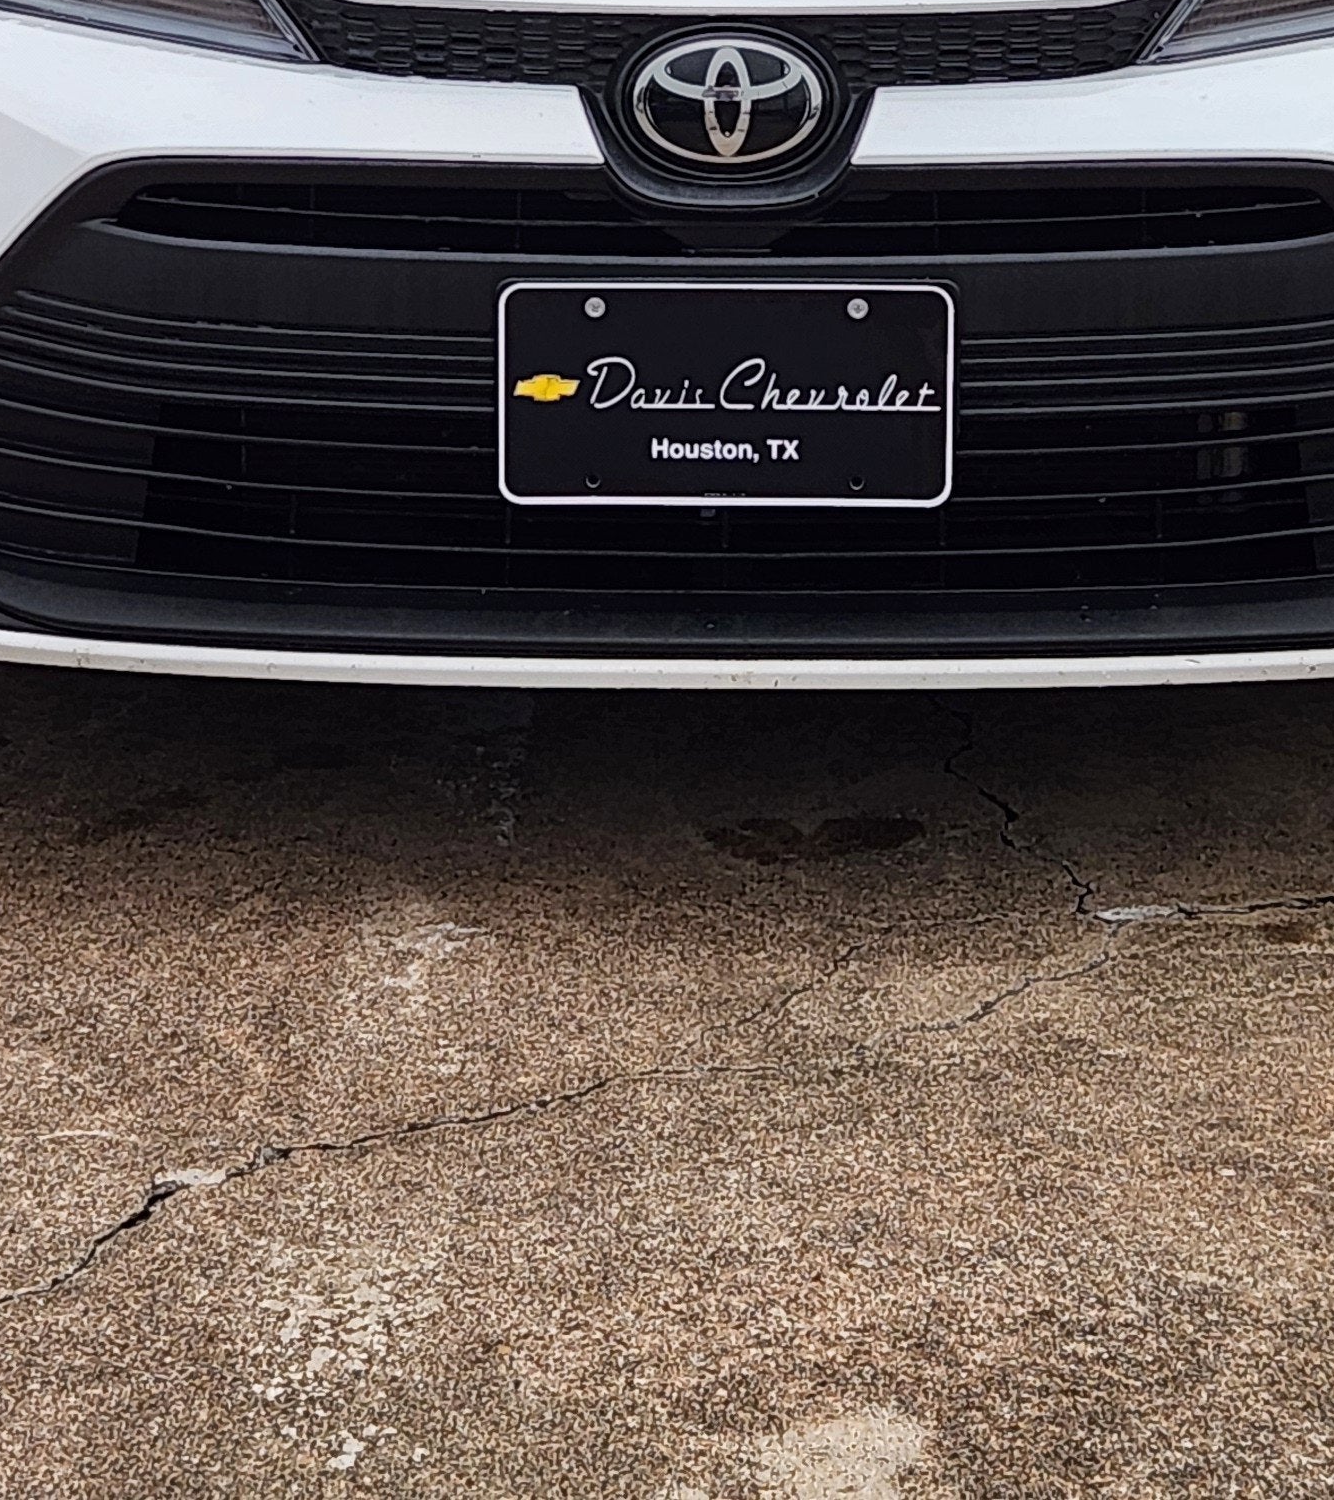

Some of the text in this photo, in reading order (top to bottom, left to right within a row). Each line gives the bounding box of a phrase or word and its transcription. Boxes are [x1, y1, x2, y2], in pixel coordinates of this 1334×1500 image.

[587, 356, 942, 411] Davis Chevrolet
[651, 437, 800, 463] Houston, TX
